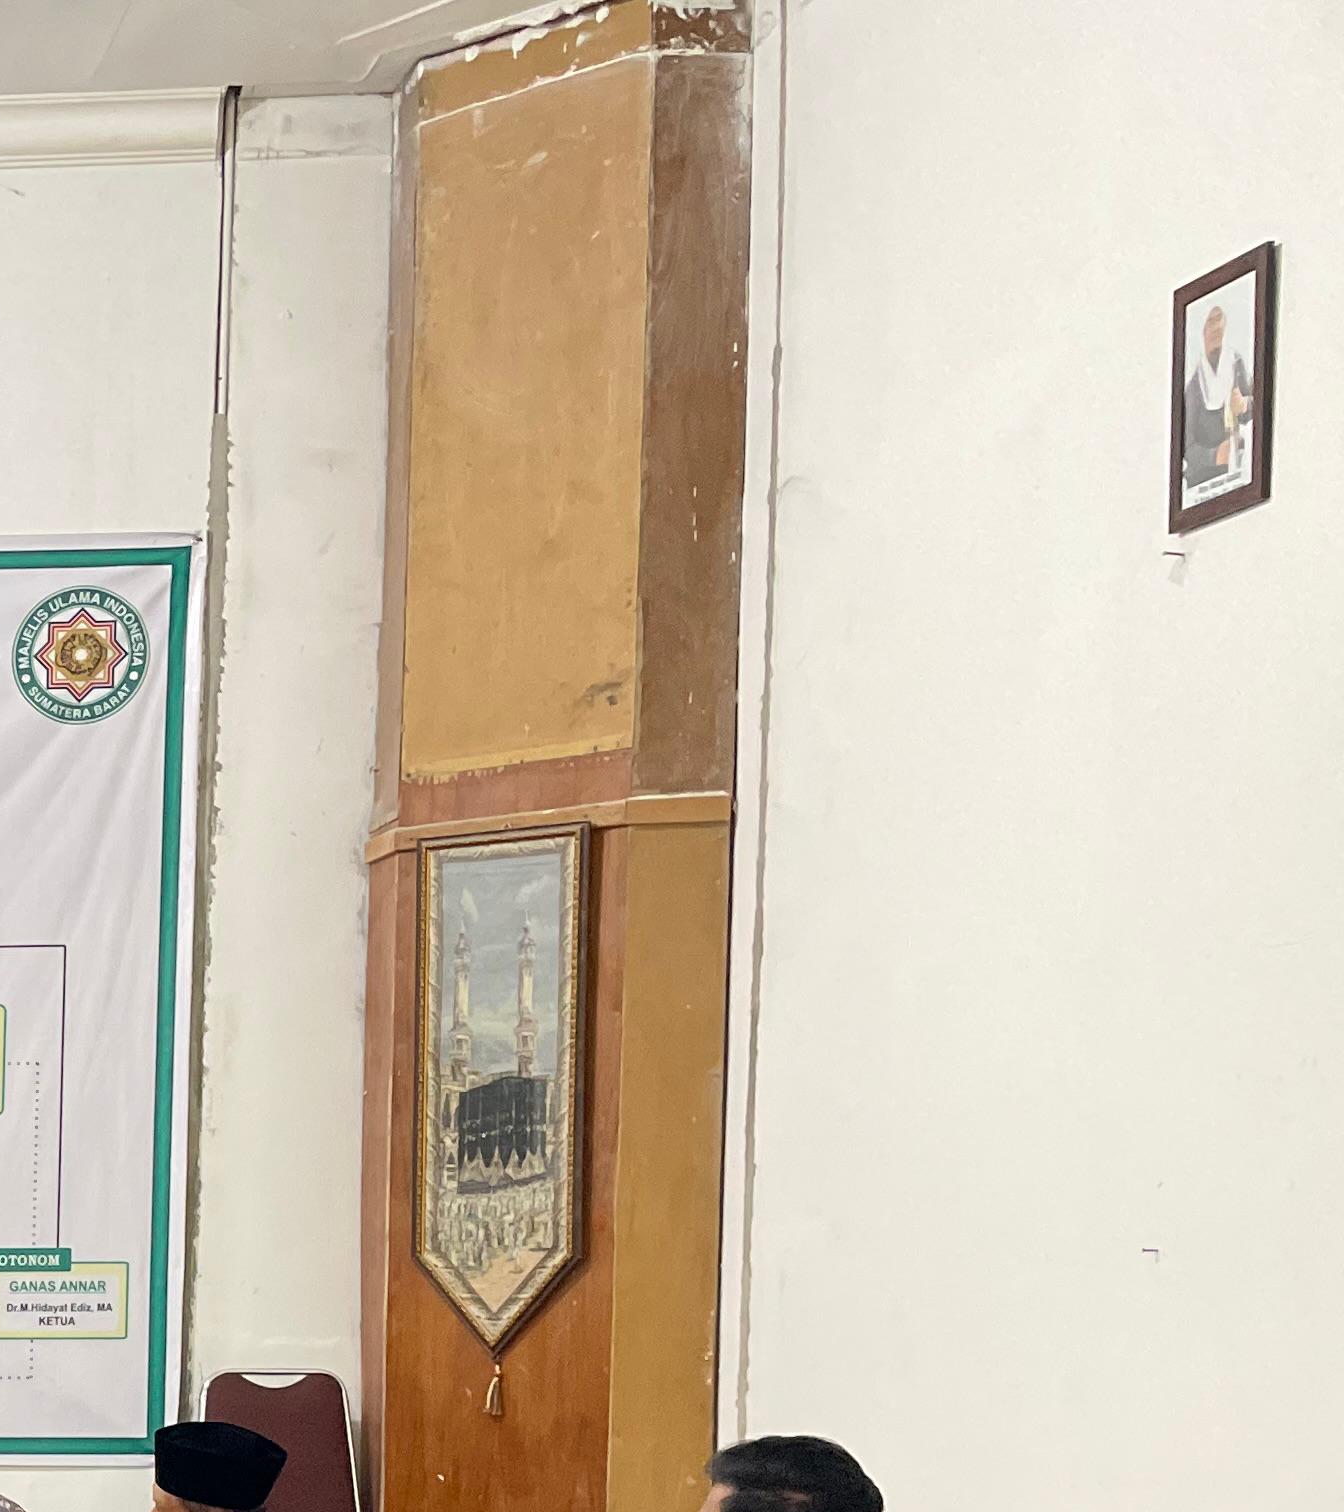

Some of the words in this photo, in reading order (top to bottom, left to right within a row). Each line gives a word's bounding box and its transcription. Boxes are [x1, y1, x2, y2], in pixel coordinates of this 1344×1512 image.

[16, 607, 50, 670] MAJELIS
[47, 591, 101, 612] ULAMA
[102, 596, 145, 667] INDONESIA
[28, 686, 92, 719] SUMATERA
[92, 683, 132, 716] BARAT
[9, 1280, 56, 1293] GANAS
[59, 1280, 107, 1293] ANNAR
[97, 1303, 113, 1312] MA
[39, 1317, 76, 1327] KETUA
